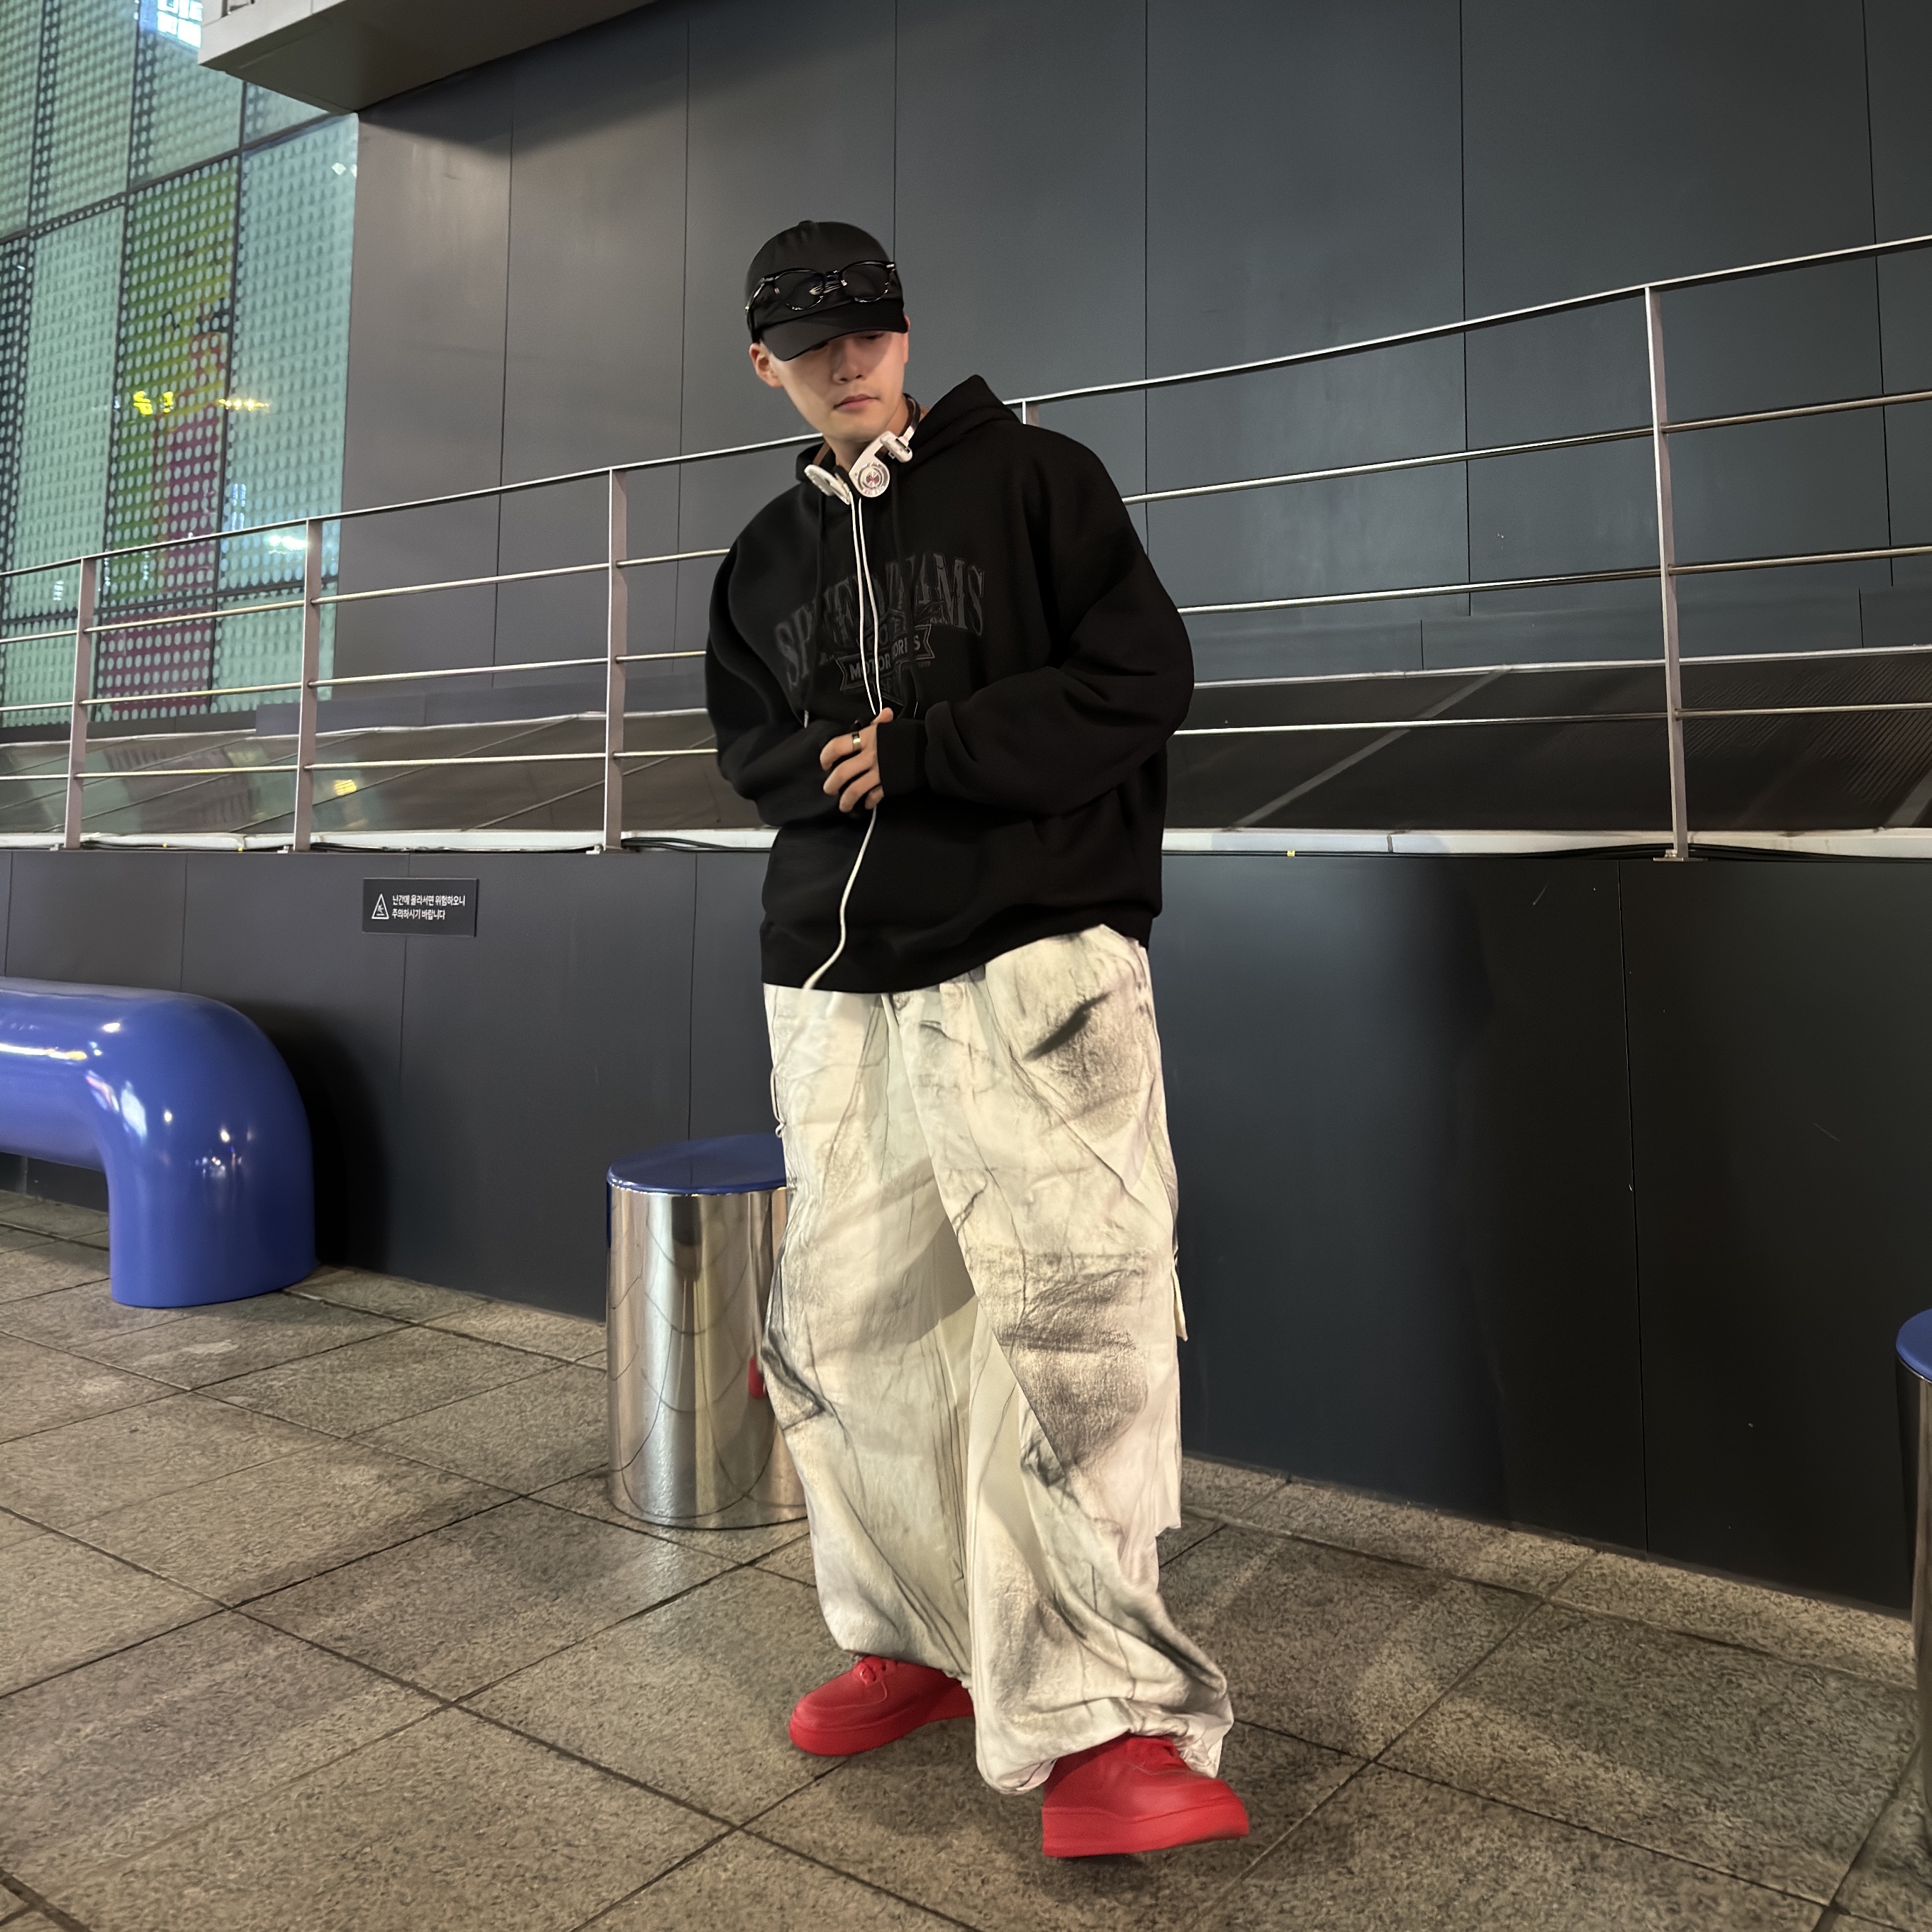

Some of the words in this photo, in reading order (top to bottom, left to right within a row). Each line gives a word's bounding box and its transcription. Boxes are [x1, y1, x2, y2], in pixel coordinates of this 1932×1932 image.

[392, 894, 410, 906] 난간에
[411, 894, 434, 906] 올라서면
[435, 895, 466, 907] 위험하오니
[391, 908, 420, 920] 주의하시기
[421, 909, 445, 920] 바랍니다
